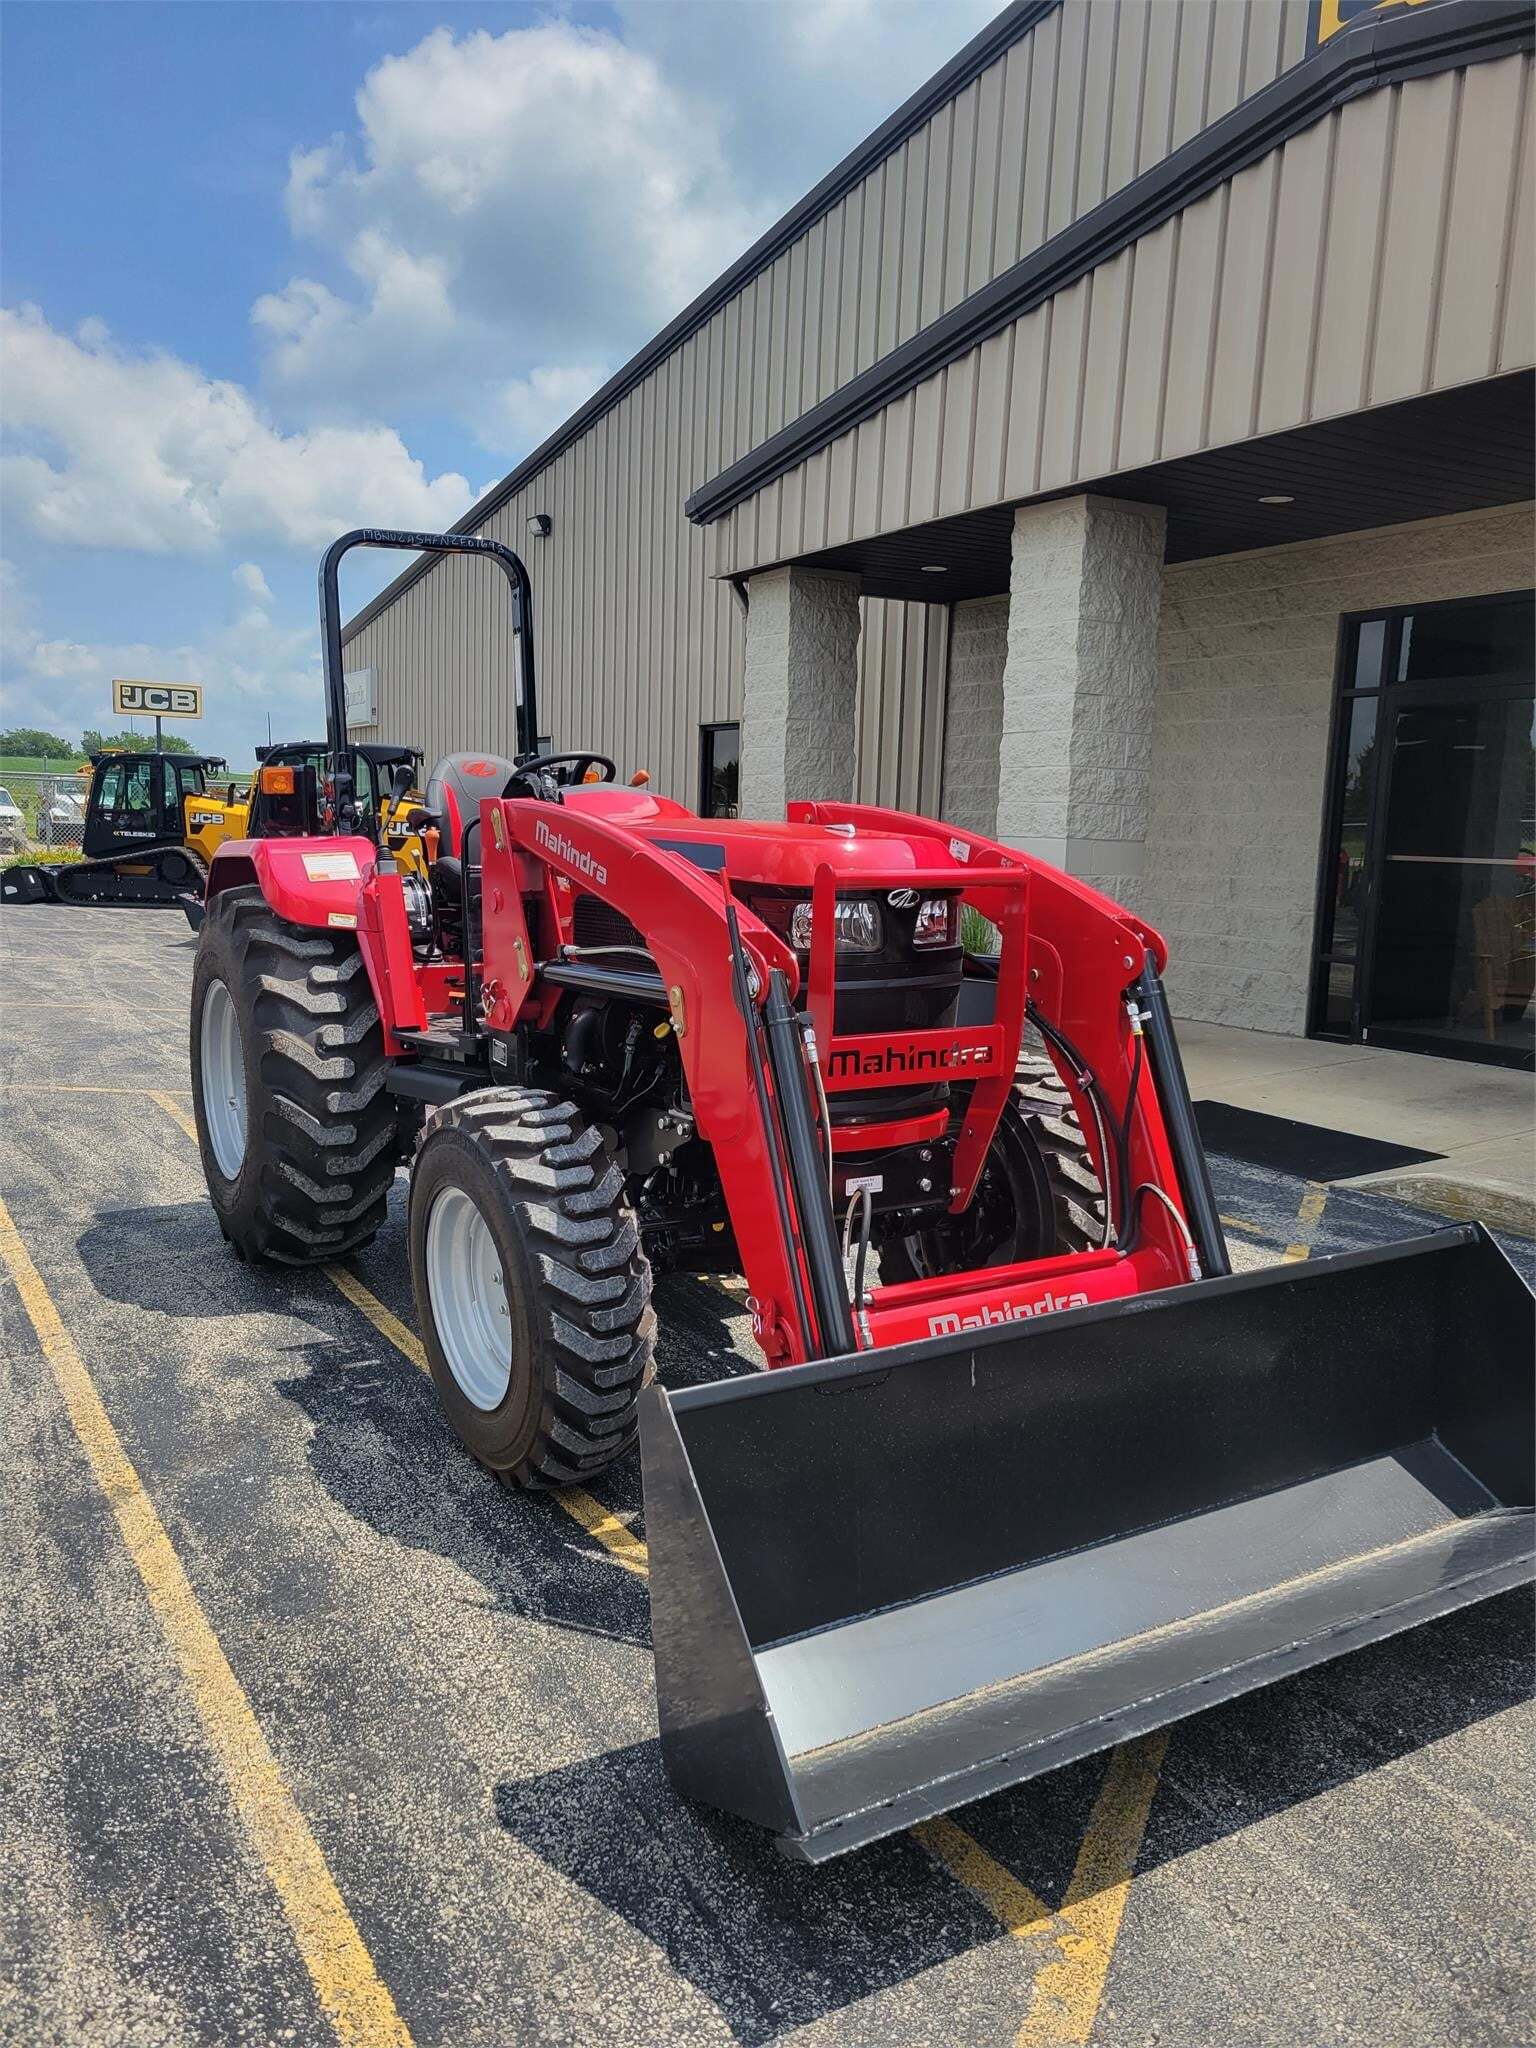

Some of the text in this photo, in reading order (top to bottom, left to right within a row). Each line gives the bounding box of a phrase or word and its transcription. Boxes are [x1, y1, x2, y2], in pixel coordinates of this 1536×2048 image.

[122, 687, 196, 711] JCB
[190, 813, 224, 824] JCB
[535, 820, 608, 885] Mahindra
[828, 1041, 992, 1077] Mahindra
